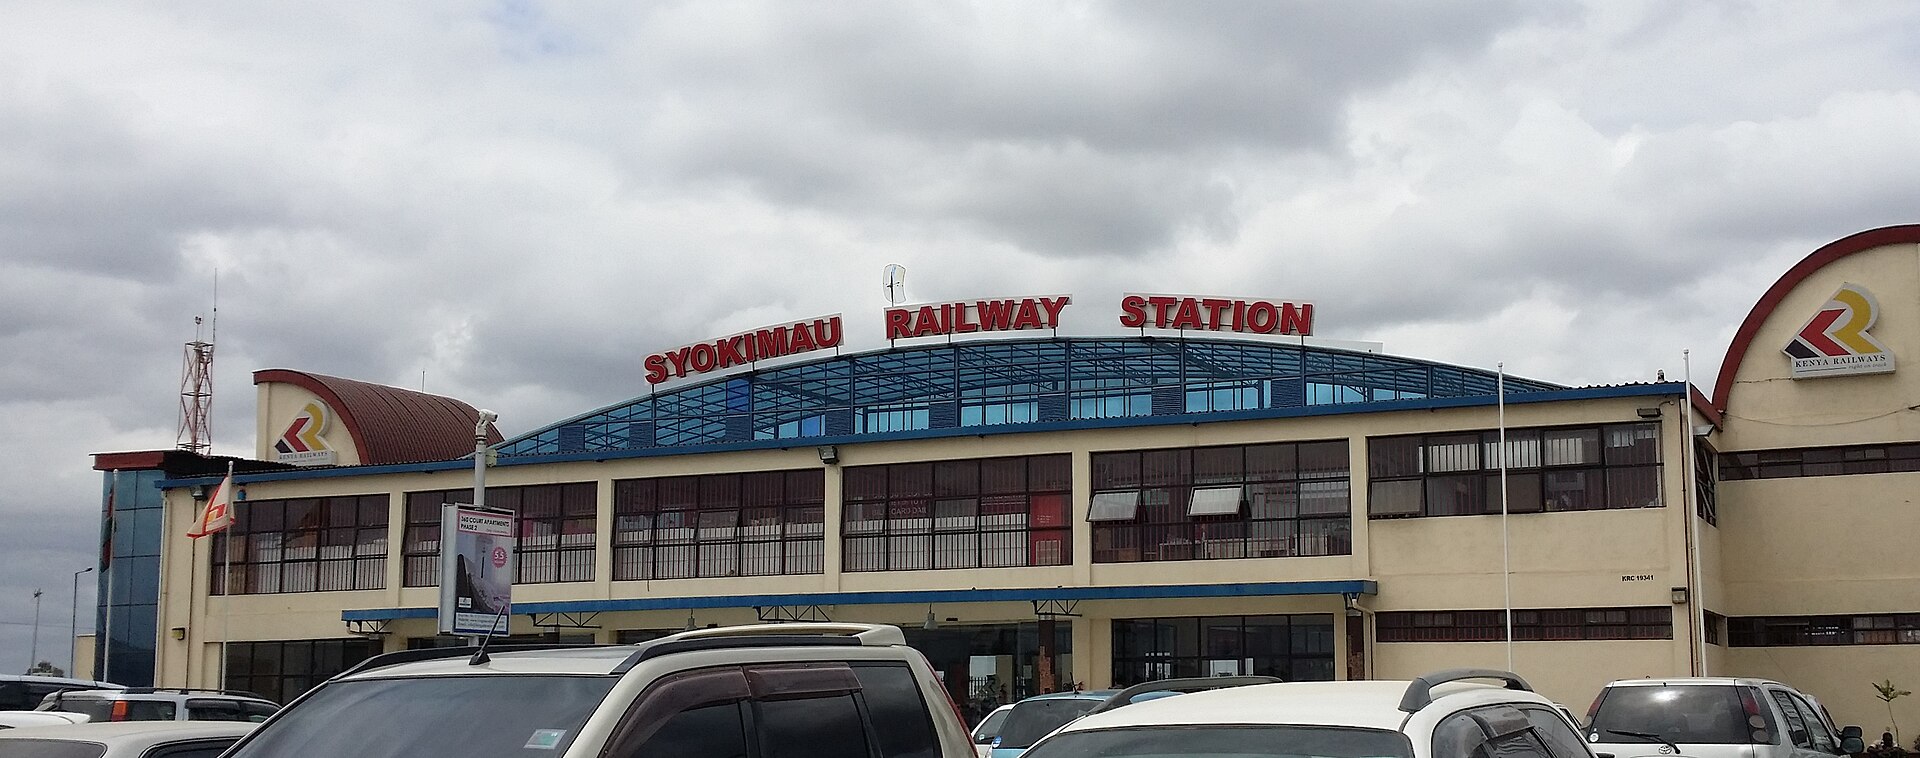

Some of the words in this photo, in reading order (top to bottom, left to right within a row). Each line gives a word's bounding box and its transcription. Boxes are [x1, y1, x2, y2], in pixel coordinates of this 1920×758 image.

[644, 316, 842, 385] SYOKIMAU
[886, 296, 1070, 339] RAILWAY
[1119, 295, 1314, 336] STATION
[1795, 358, 1829, 368] KENYA
[1833, 354, 1887, 365] RAILWAYS
[469, 517, 484, 525] COURT
[484, 518, 510, 527] APARTMENTS
